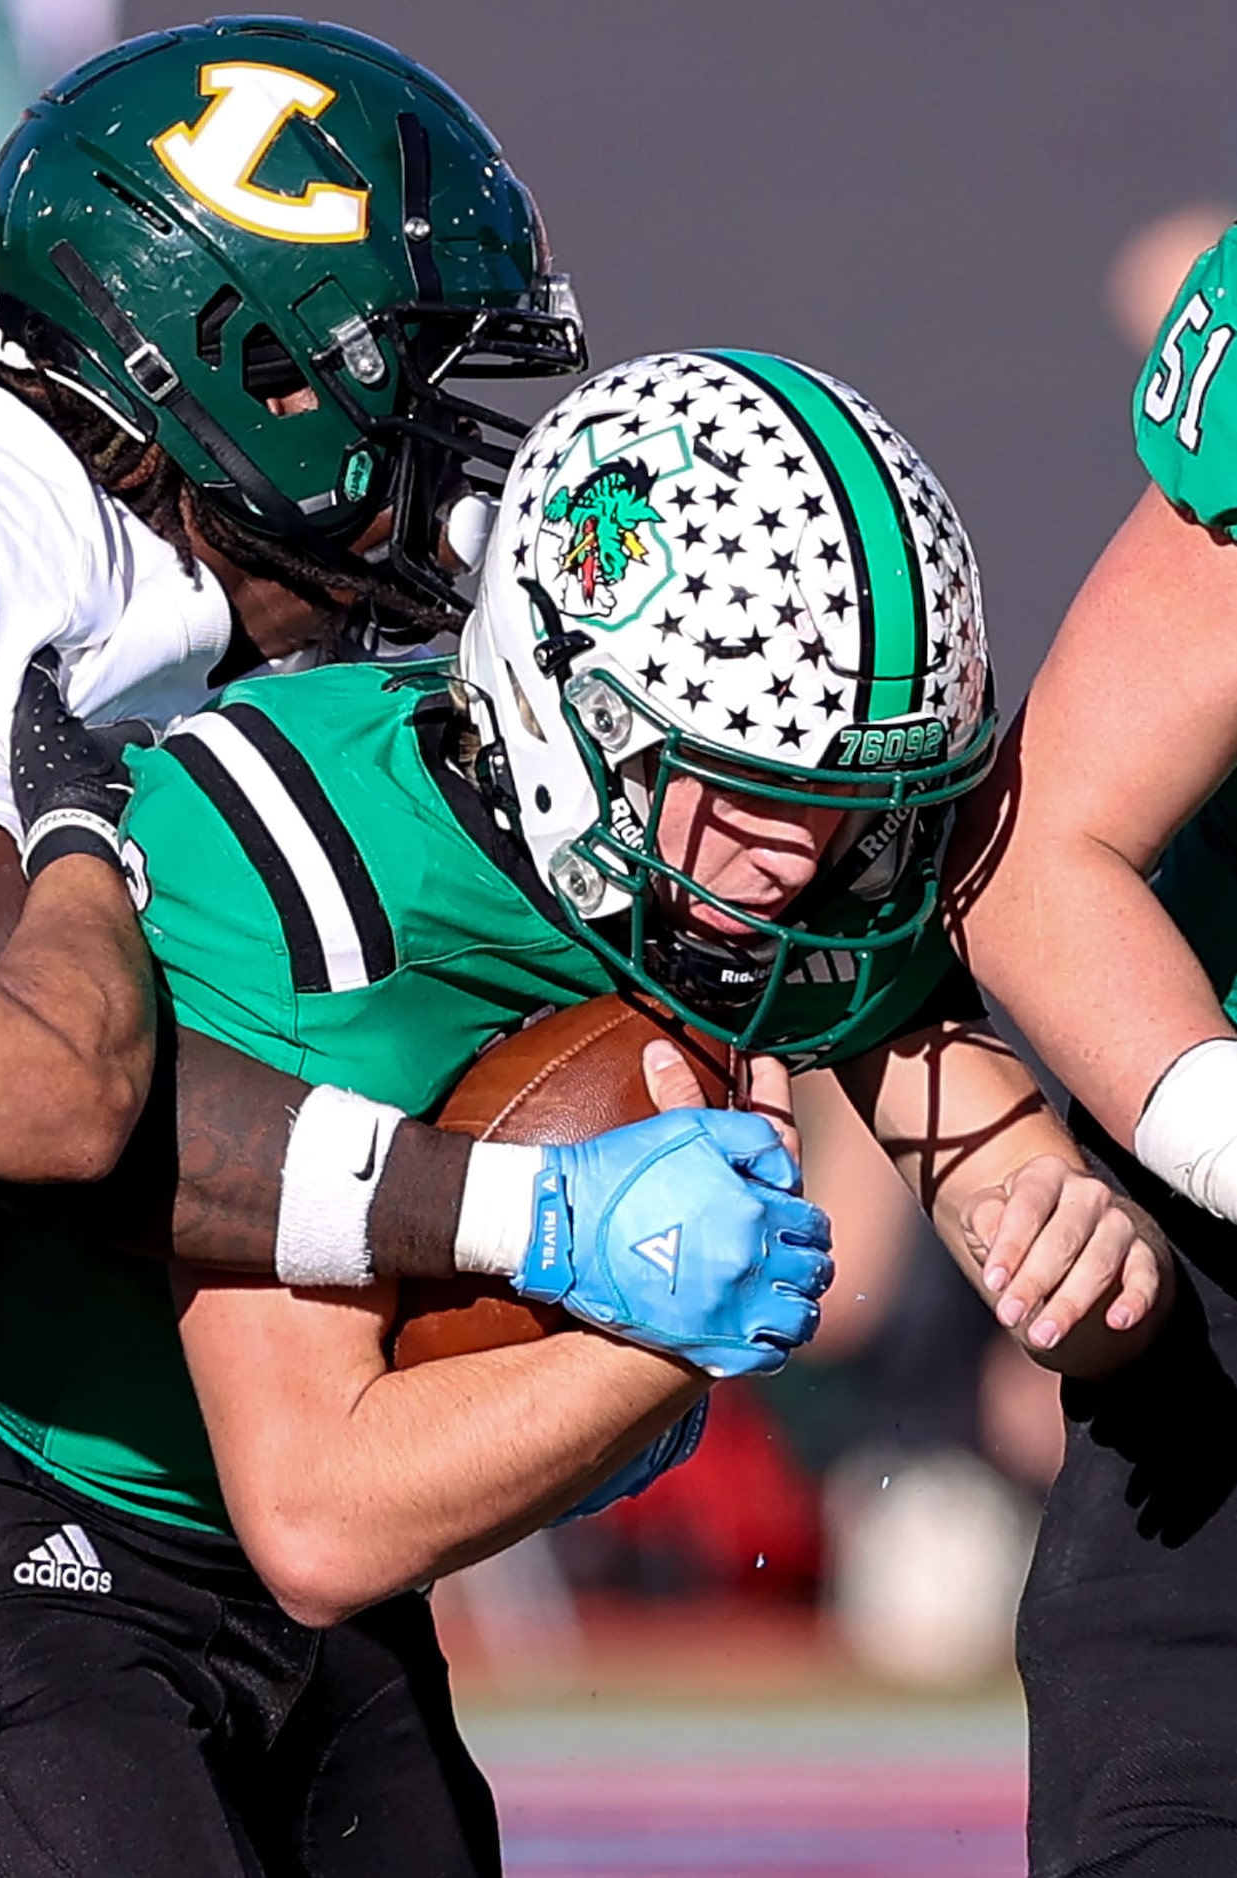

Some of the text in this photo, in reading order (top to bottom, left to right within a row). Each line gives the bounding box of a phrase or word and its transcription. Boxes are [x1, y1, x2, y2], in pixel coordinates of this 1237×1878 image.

[152, 61, 369, 244] L
[1143, 289, 1236, 456] 51
[837, 721, 944, 765] 76092
[13, 1559, 112, 1593] adidas
